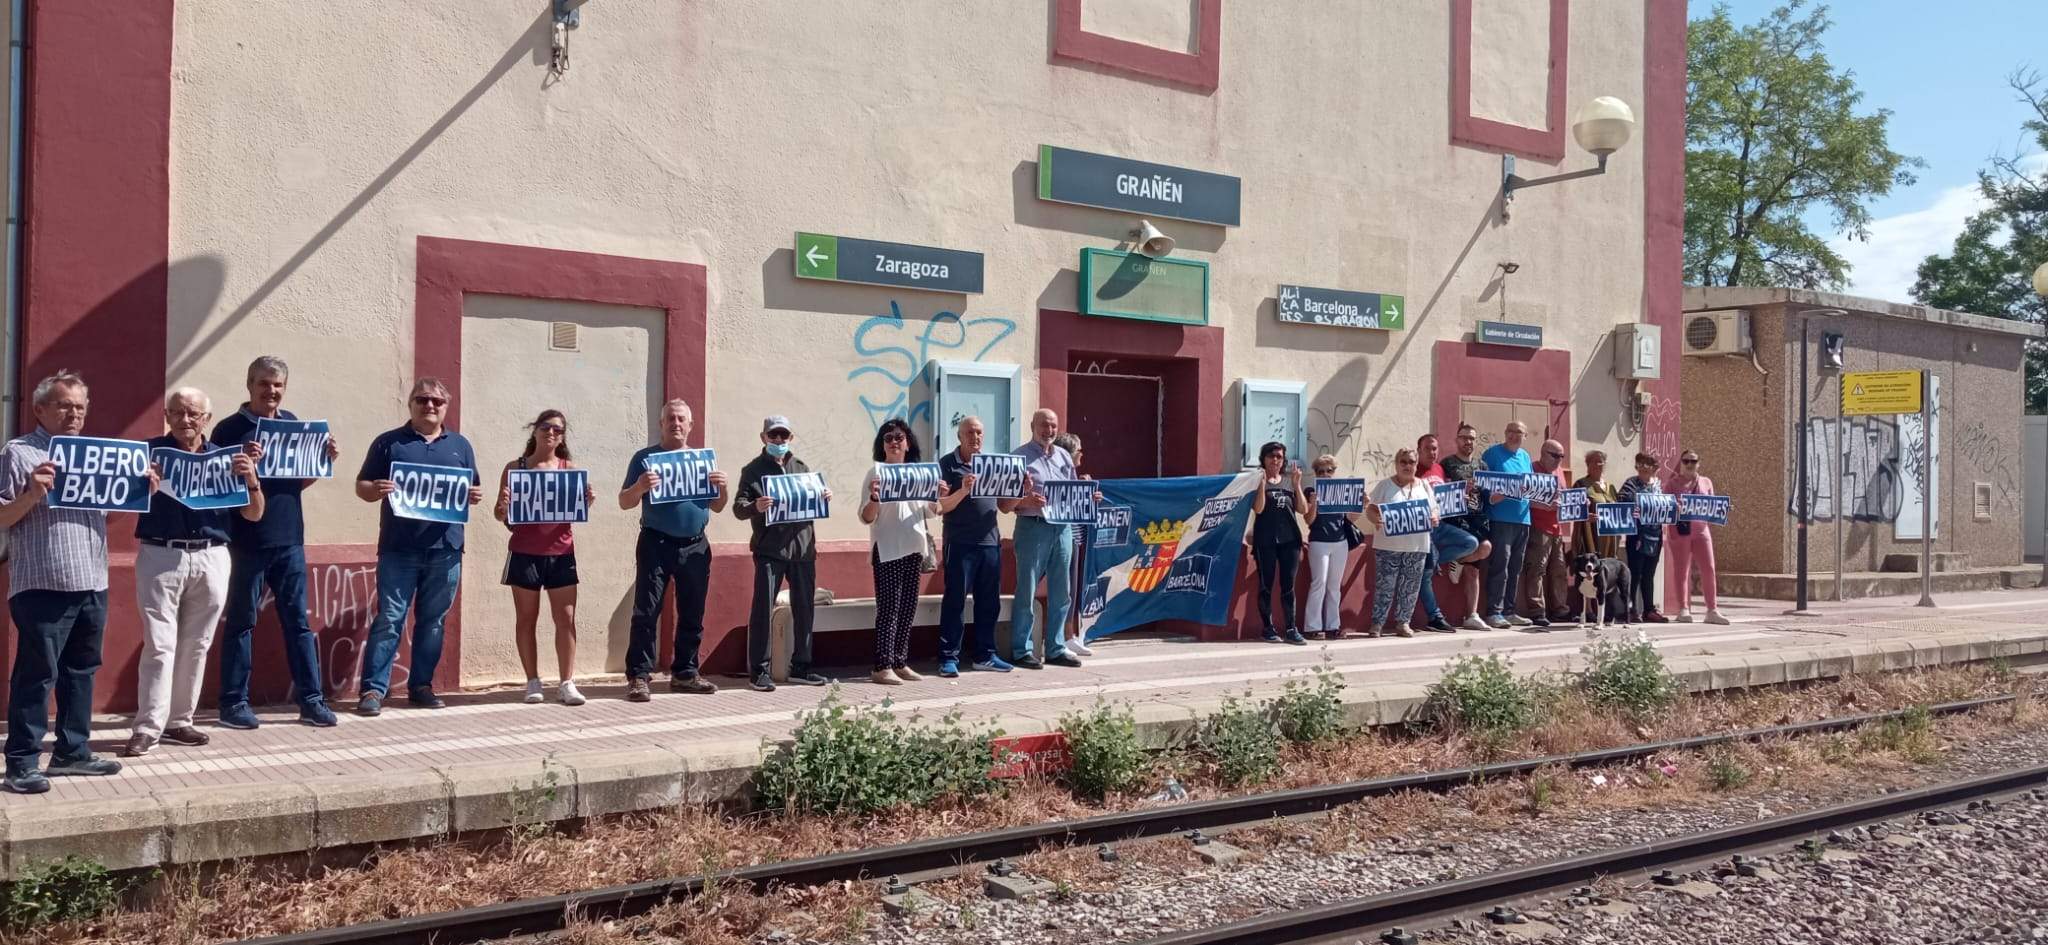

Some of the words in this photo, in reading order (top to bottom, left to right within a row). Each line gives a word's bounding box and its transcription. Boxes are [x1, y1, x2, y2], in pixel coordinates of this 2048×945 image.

[1116, 174, 1183, 203] GRAÑÉN
[875, 254, 950, 280] Zaragoza
[1304, 298, 1359, 316] Barcelona
[51, 443, 149, 477] ALBERO
[60, 474, 130, 506] BAJO
[154, 454, 247, 500] LCUBIERRE
[391, 469, 470, 512] SODETO
[879, 466, 940, 499] VALFONDA
[974, 456, 1025, 497] ROBRES
[510, 472, 586, 522] FRAELLA
[1316, 484, 1364, 506] ALMUNIENTE
[1560, 490, 1588, 507] LBERO
[1640, 494, 1673, 523] CURBE
[1681, 498, 1729, 520] BARBUES
[1561, 505, 1581, 521] BAJO
[1598, 506, 1635, 529] FRULA
